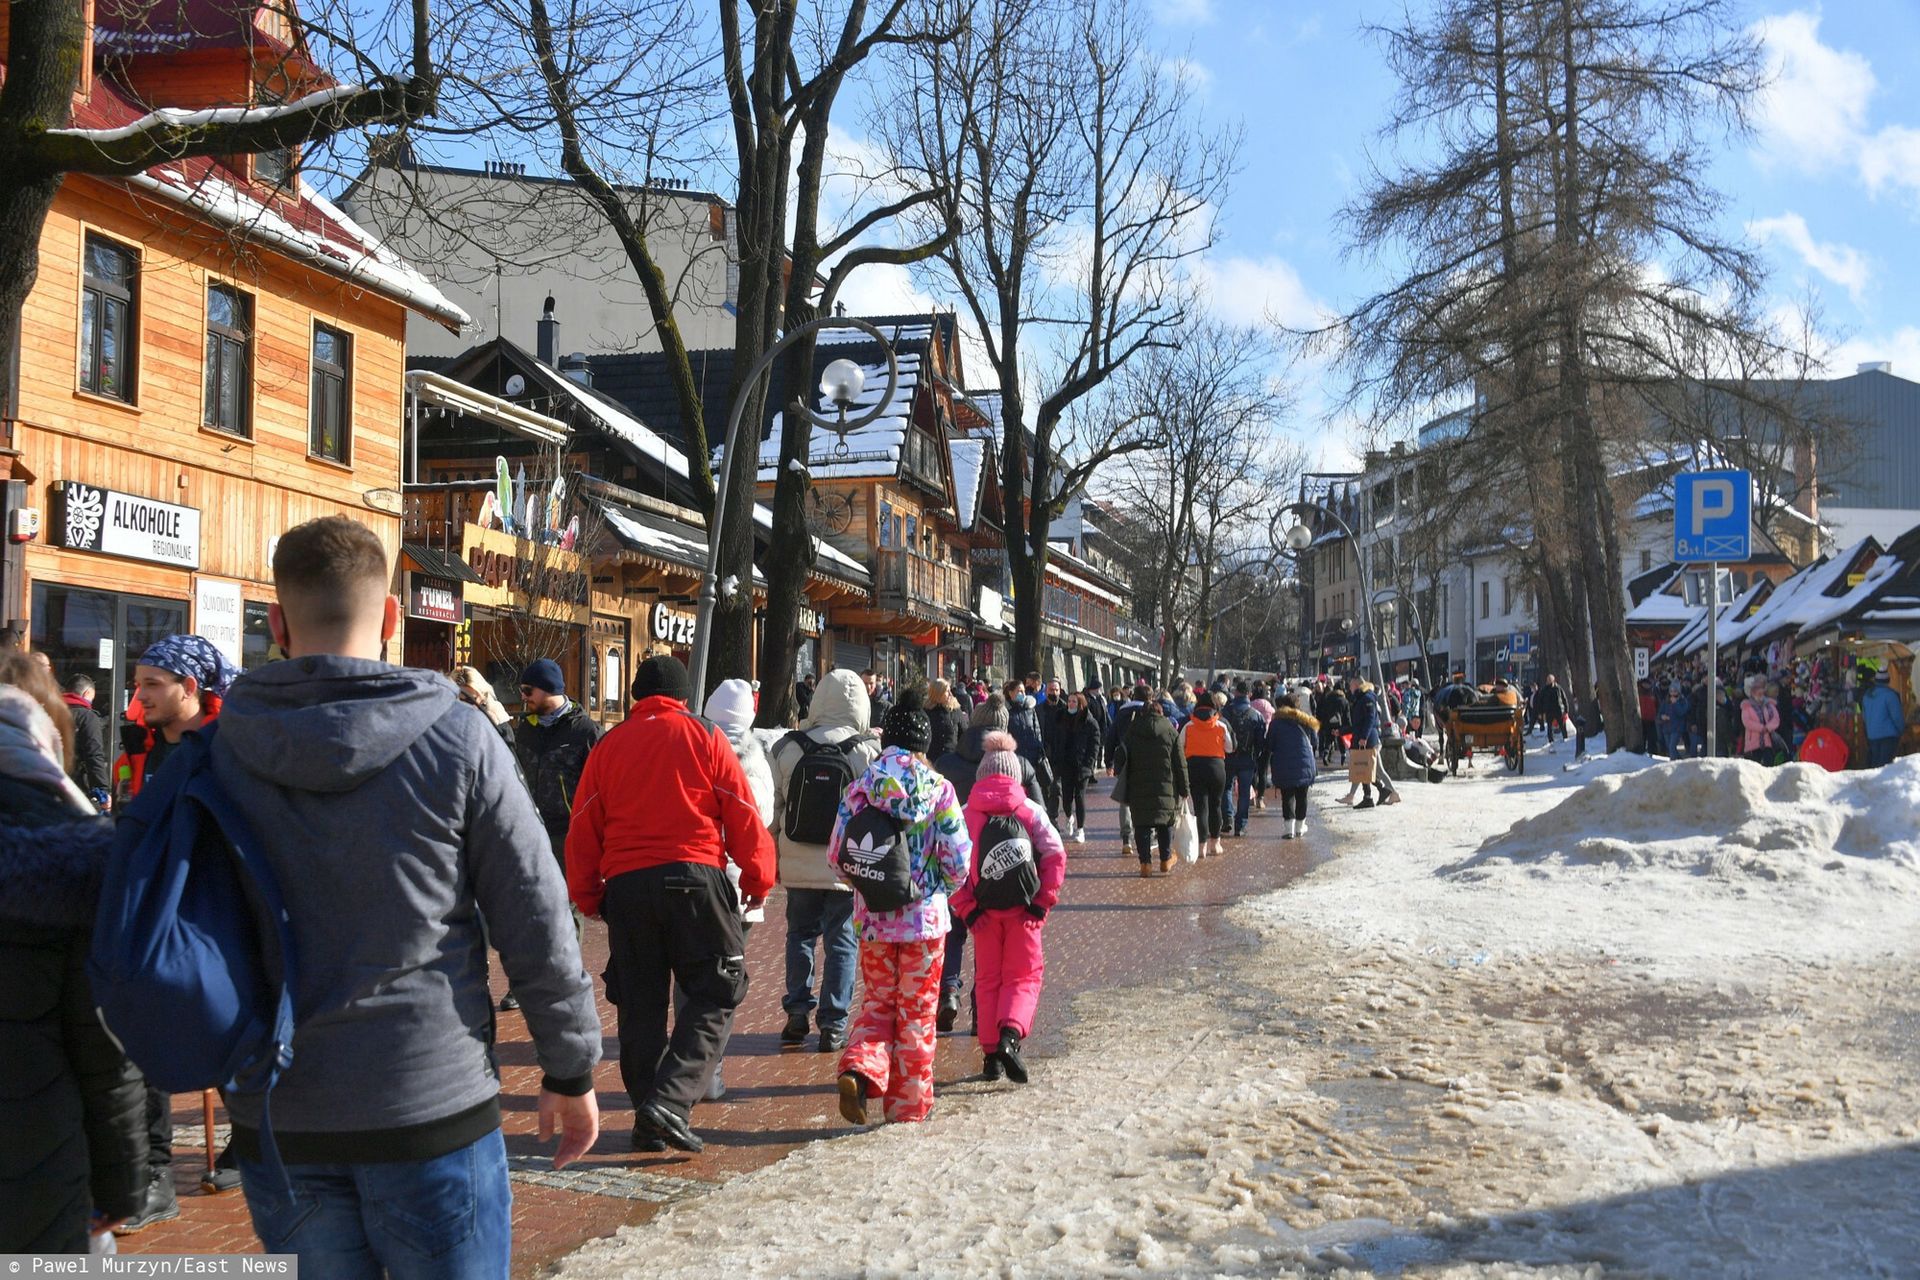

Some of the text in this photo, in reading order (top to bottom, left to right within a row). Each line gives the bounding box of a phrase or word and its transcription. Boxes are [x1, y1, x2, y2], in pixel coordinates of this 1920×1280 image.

[1691, 479, 1734, 535] P
[113, 499, 181, 539] ALKOHOLE
[152, 539, 192, 560] REGIONALNE
[418, 607, 456, 620] RESTAURACJA
[655, 602, 696, 645] Grza
[1514, 635, 1525, 650] P
[990, 841, 1013, 860] VANS
[843, 862, 886, 882] adidas
[984, 863, 998, 875] OFF
[997, 851, 1016, 870] THE
